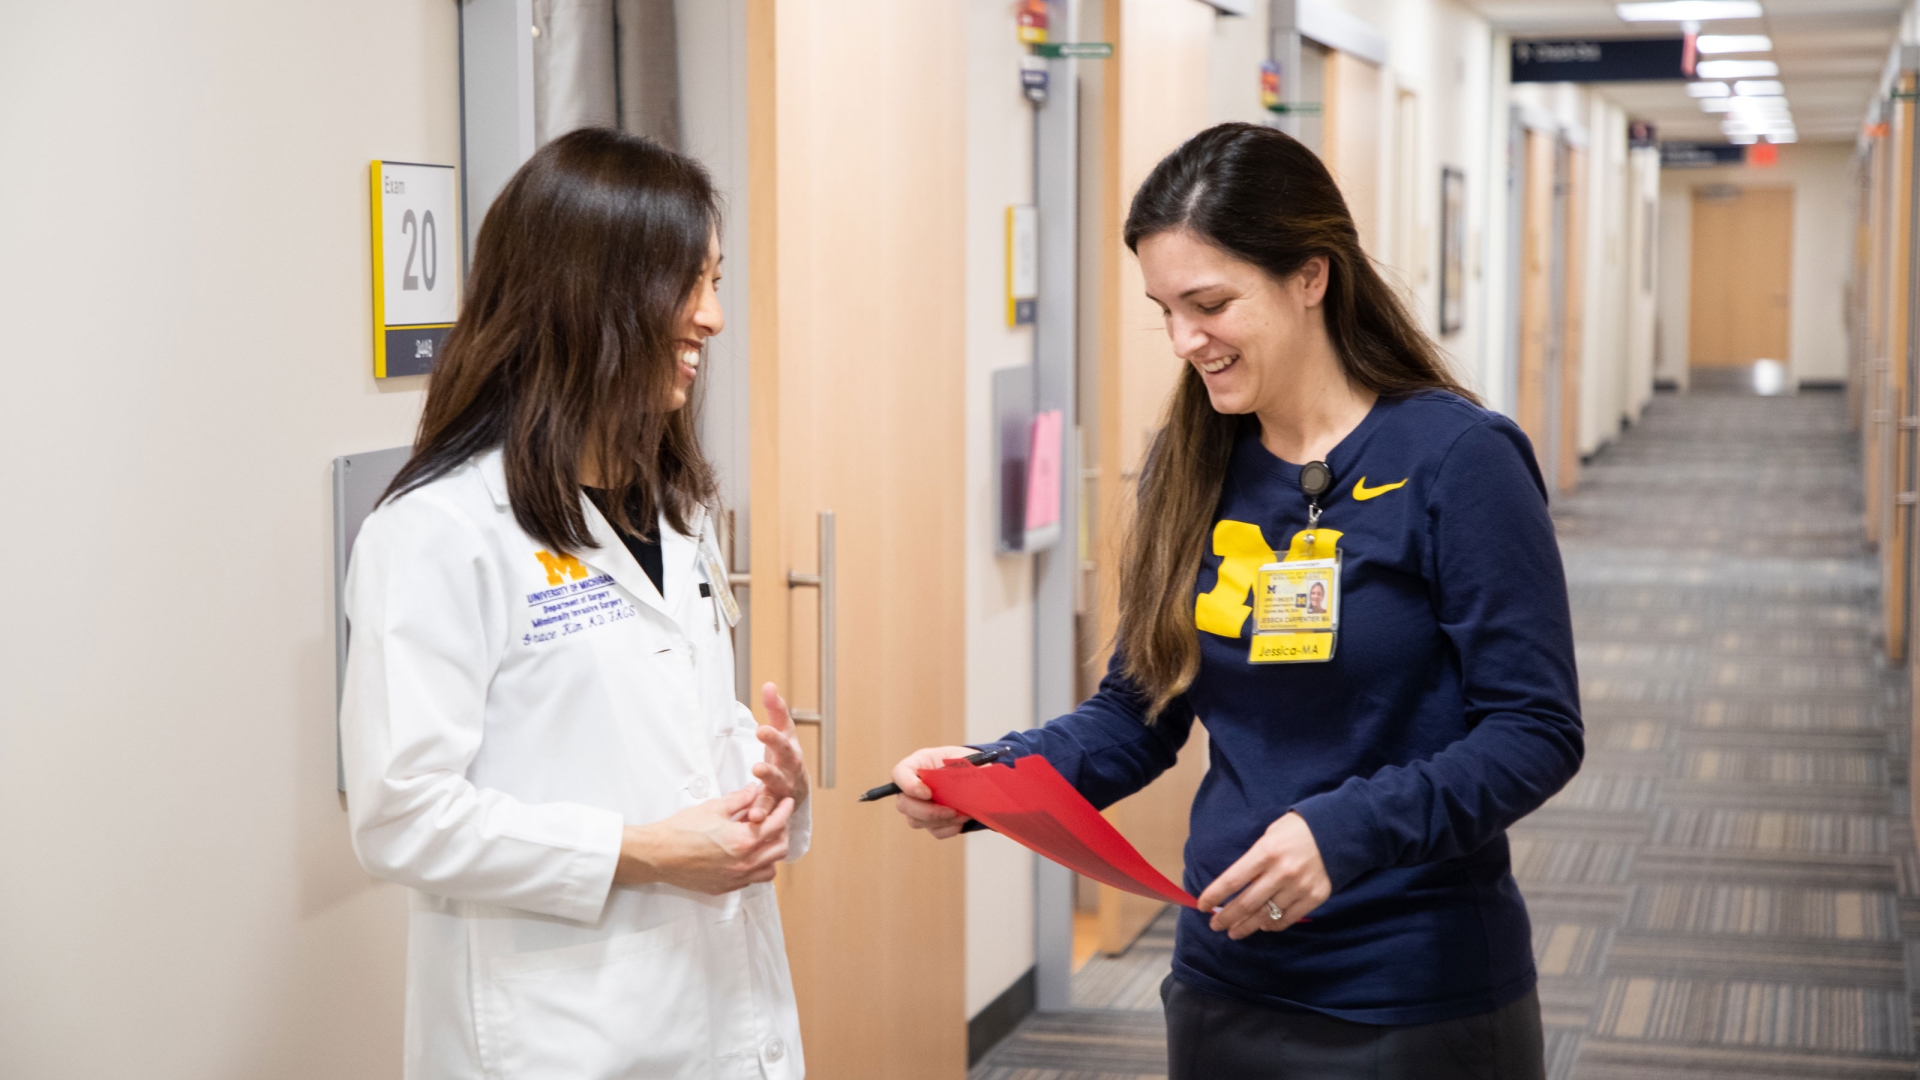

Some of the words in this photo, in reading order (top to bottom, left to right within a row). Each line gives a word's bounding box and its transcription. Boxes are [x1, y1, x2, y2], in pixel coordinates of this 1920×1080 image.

[385, 175, 406, 195] Exam
[401, 208, 437, 292] 20
[535, 549, 590, 587] M
[526, 586, 569, 604] UNIVERSITY
[569, 583, 578, 593] OF
[1258, 644, 1319, 657] Jessica-MA
